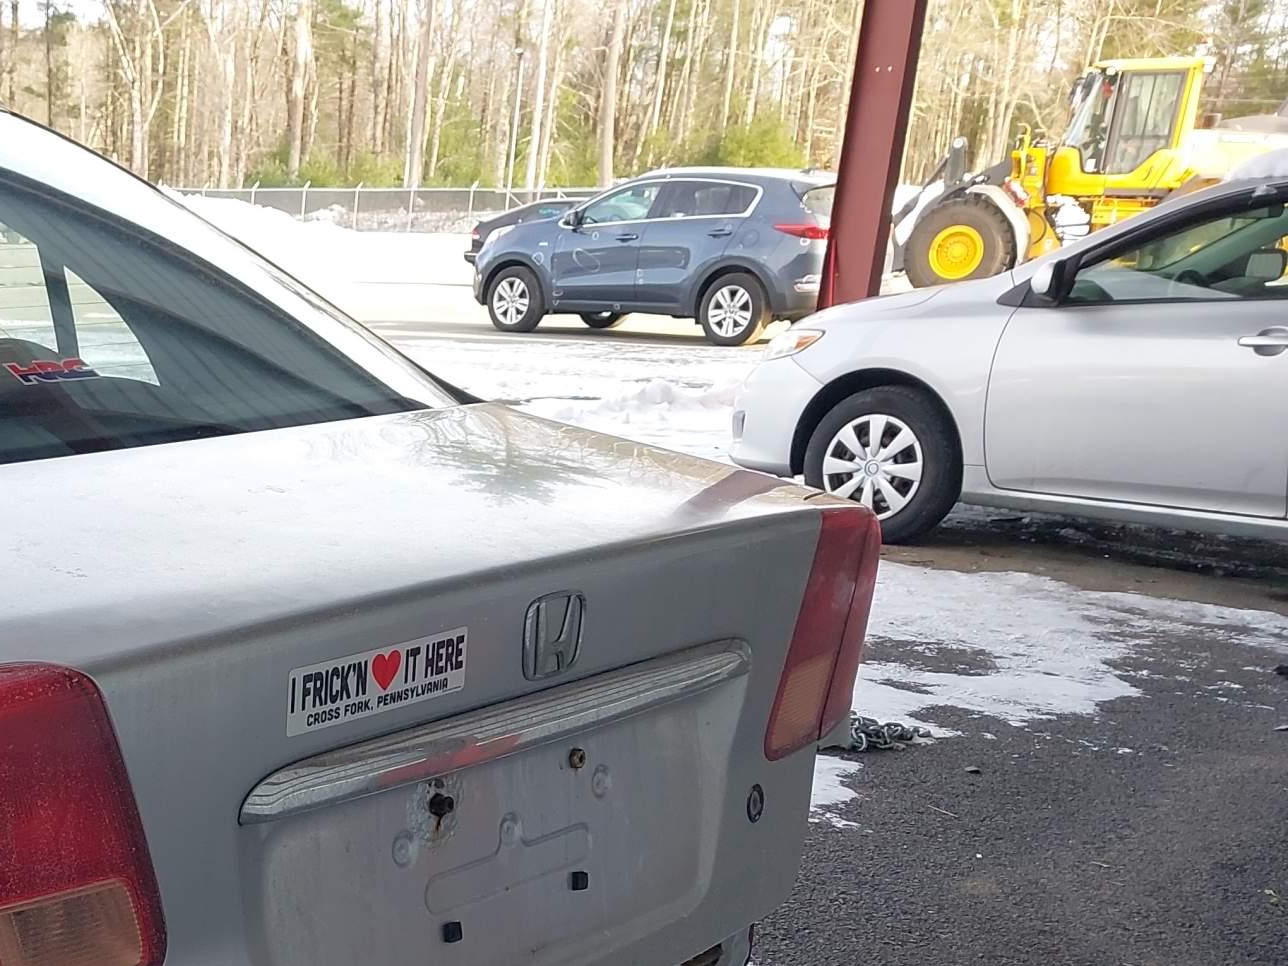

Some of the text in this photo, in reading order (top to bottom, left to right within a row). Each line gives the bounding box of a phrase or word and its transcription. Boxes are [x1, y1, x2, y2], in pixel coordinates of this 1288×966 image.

[291, 635, 465, 714] I FRICK'N IT HERE
[306, 677, 448, 727] CROSS FORK, PENNSYLVANIA
